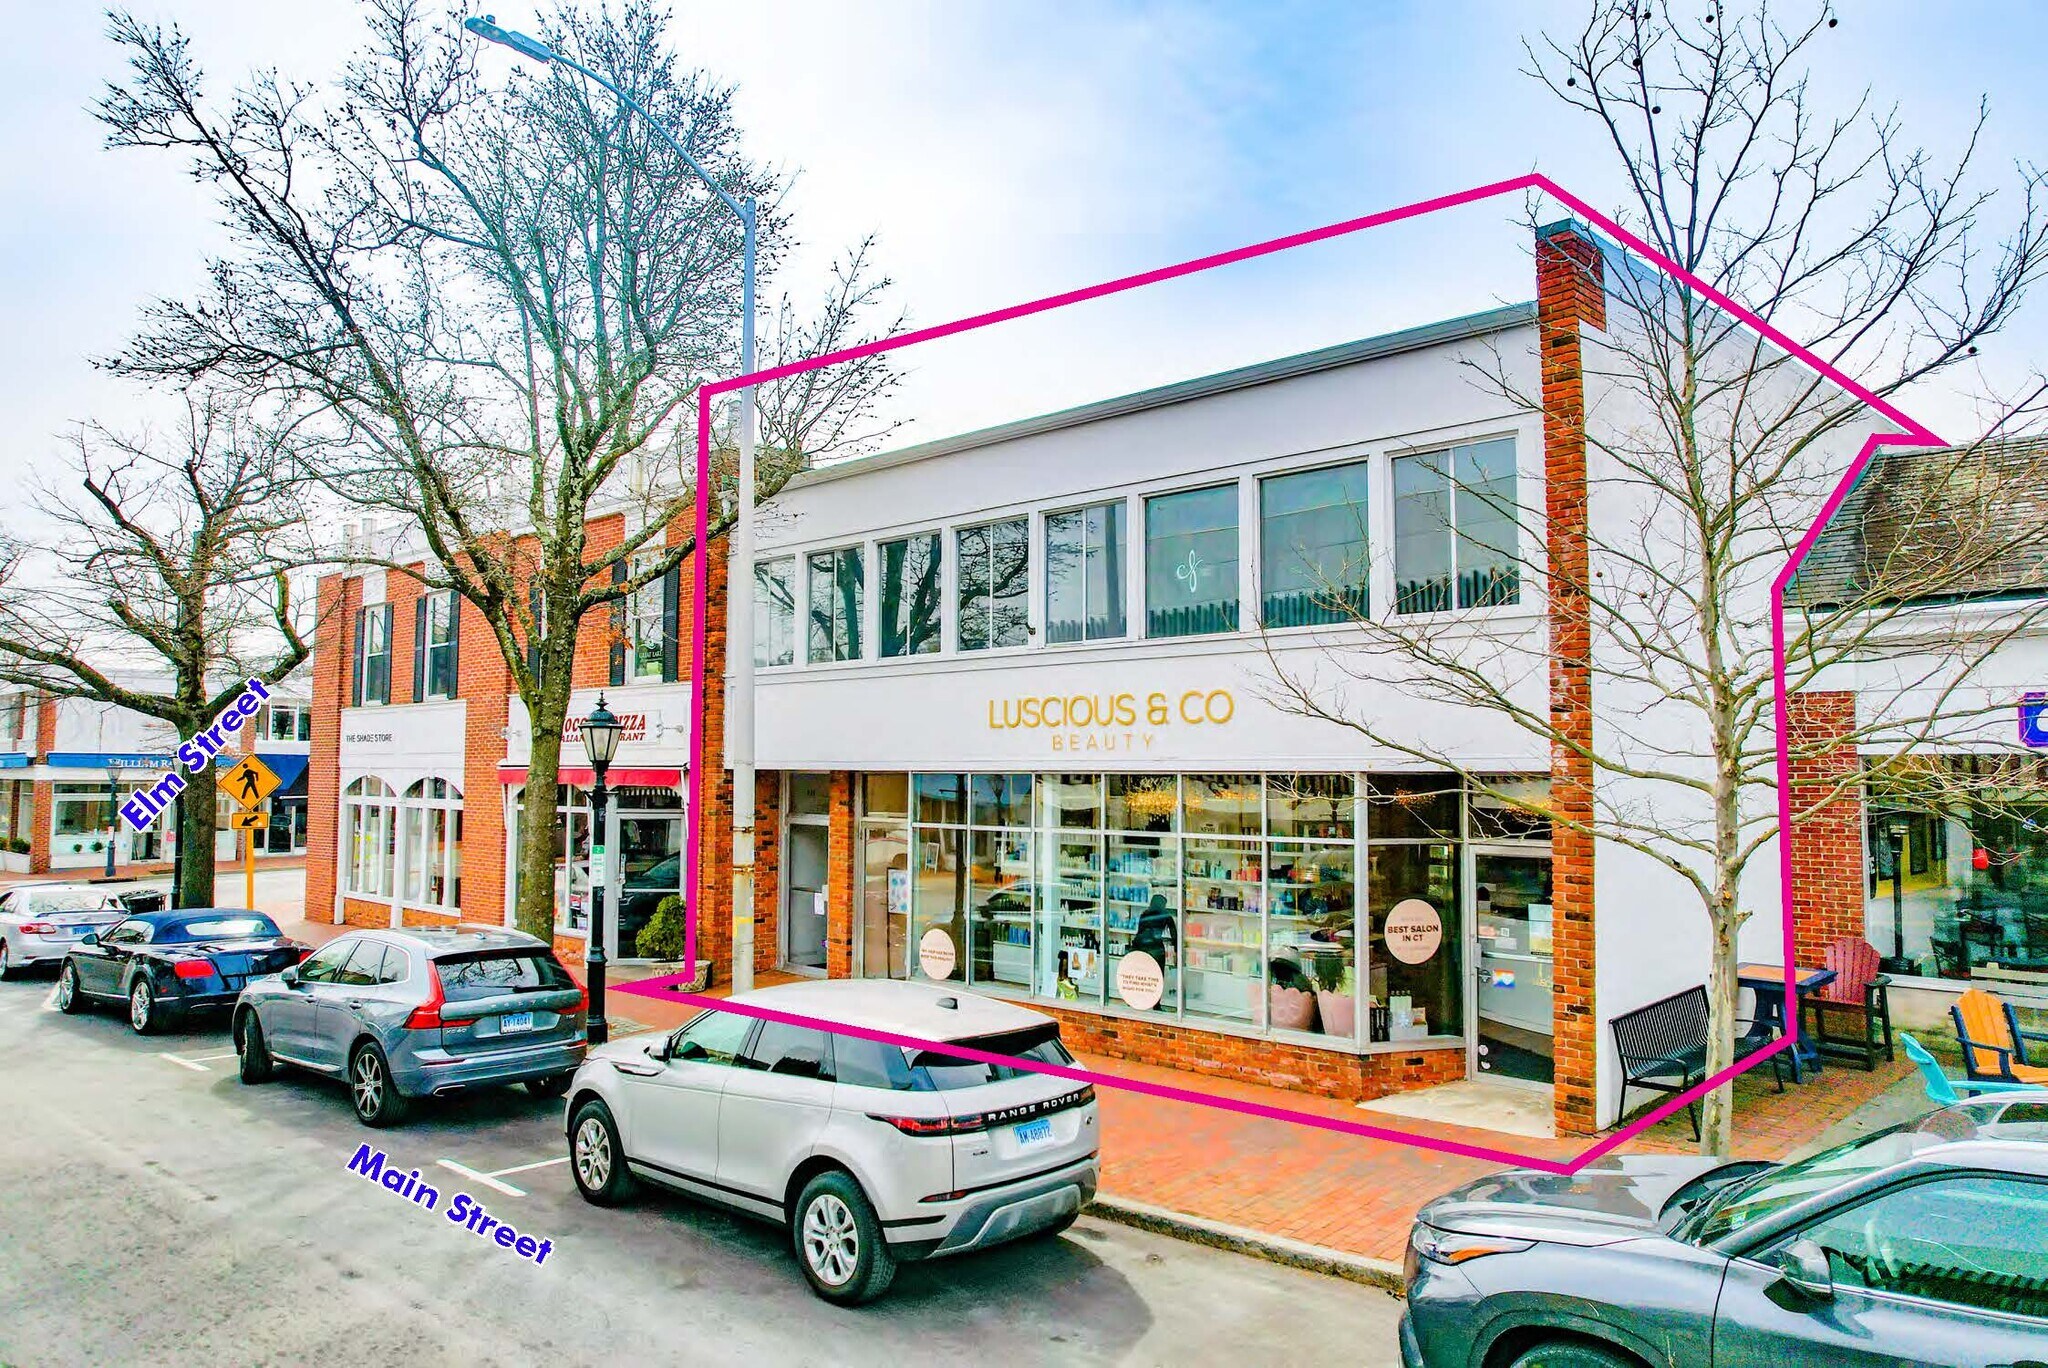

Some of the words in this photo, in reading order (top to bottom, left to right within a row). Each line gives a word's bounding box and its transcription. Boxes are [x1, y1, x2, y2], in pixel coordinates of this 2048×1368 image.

[988, 692, 1137, 729] LUSCIOUS
[1146, 692, 1169, 726] &
[1179, 689, 1236, 725] CO
[346, 734, 356, 743] THE
[374, 733, 392, 742] STORE
[1051, 732, 1157, 751] BEAUTY
[1387, 926, 1409, 934] BEST
[1410, 924, 1439, 933] SALON
[1413, 934, 1423, 942] CT
[987, 1104, 1036, 1121] RANGE
[1042, 1093, 1079, 1110] ROVER
